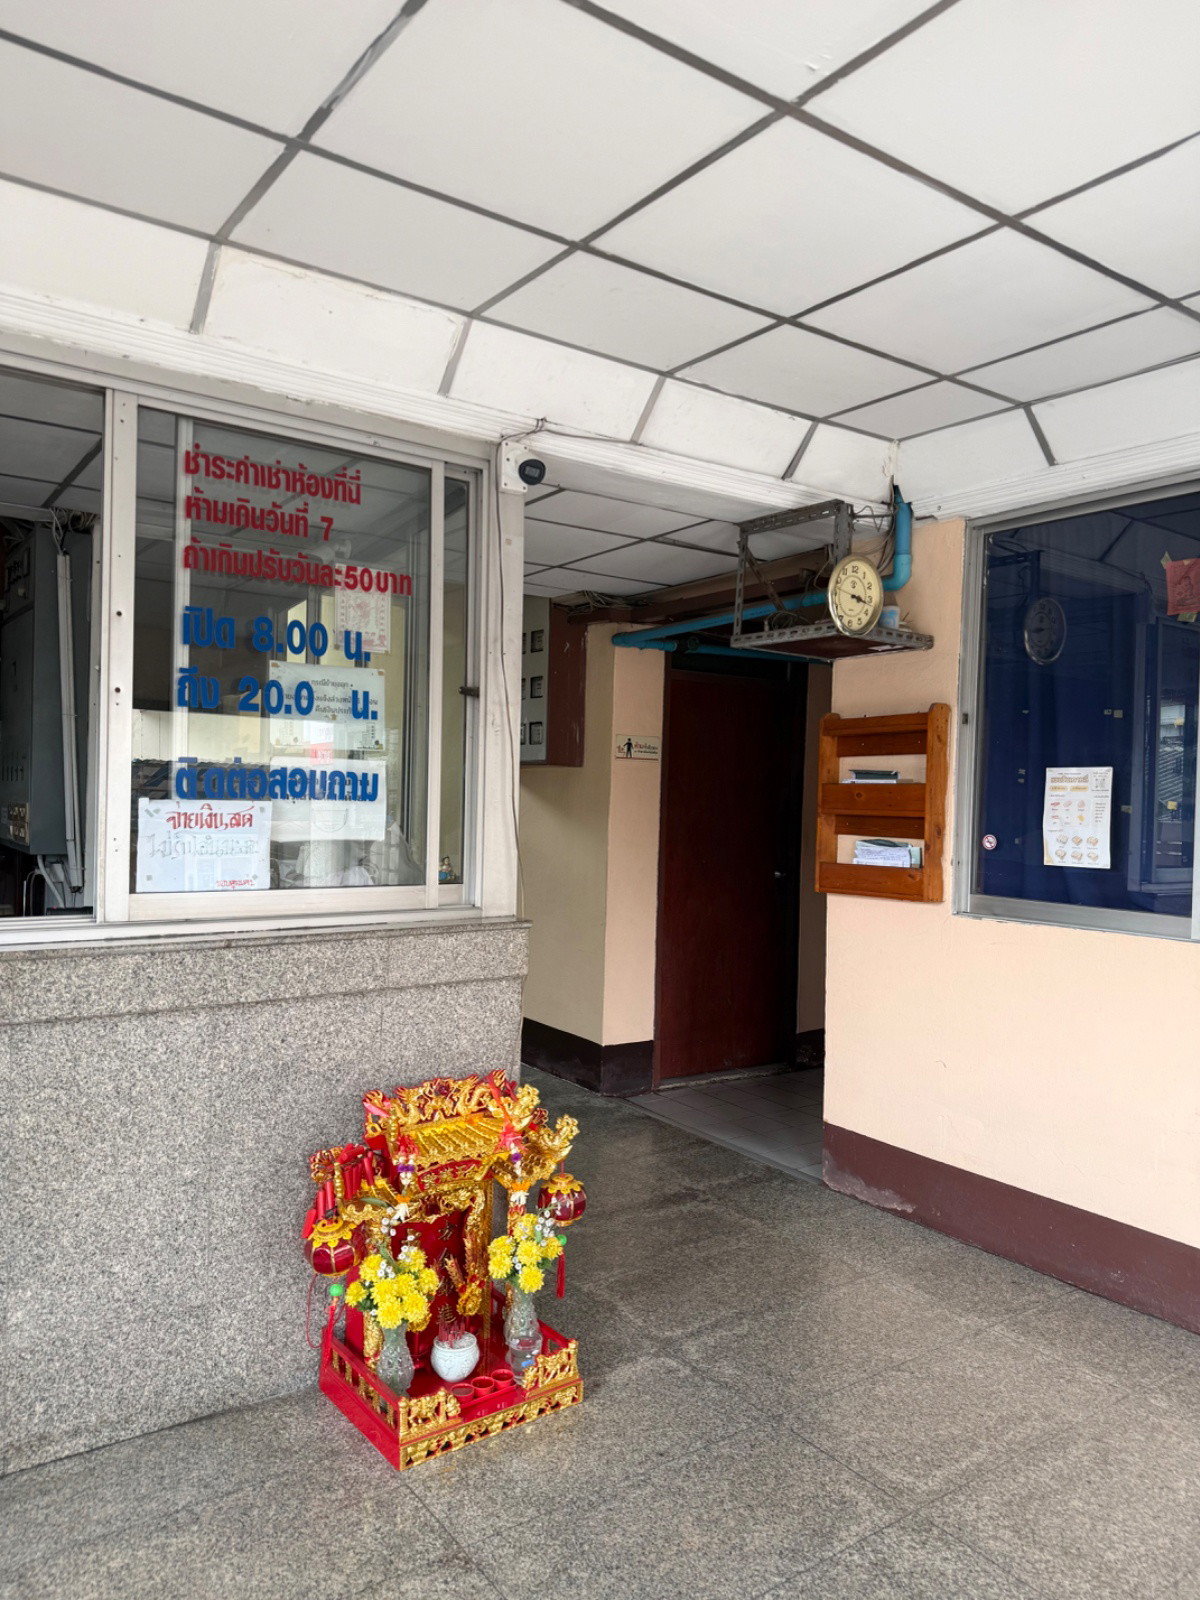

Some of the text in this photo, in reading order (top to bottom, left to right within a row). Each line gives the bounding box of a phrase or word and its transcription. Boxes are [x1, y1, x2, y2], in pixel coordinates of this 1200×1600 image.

[184, 443, 361, 505] ชำระค่าเช่าห้องที่นี่
[185, 487, 334, 541] ห้ามเกินวันที่ 7
[182, 606, 371, 662] เปิด 8.00 น.
[177, 665, 378, 721] ถึง 20.0 น.
